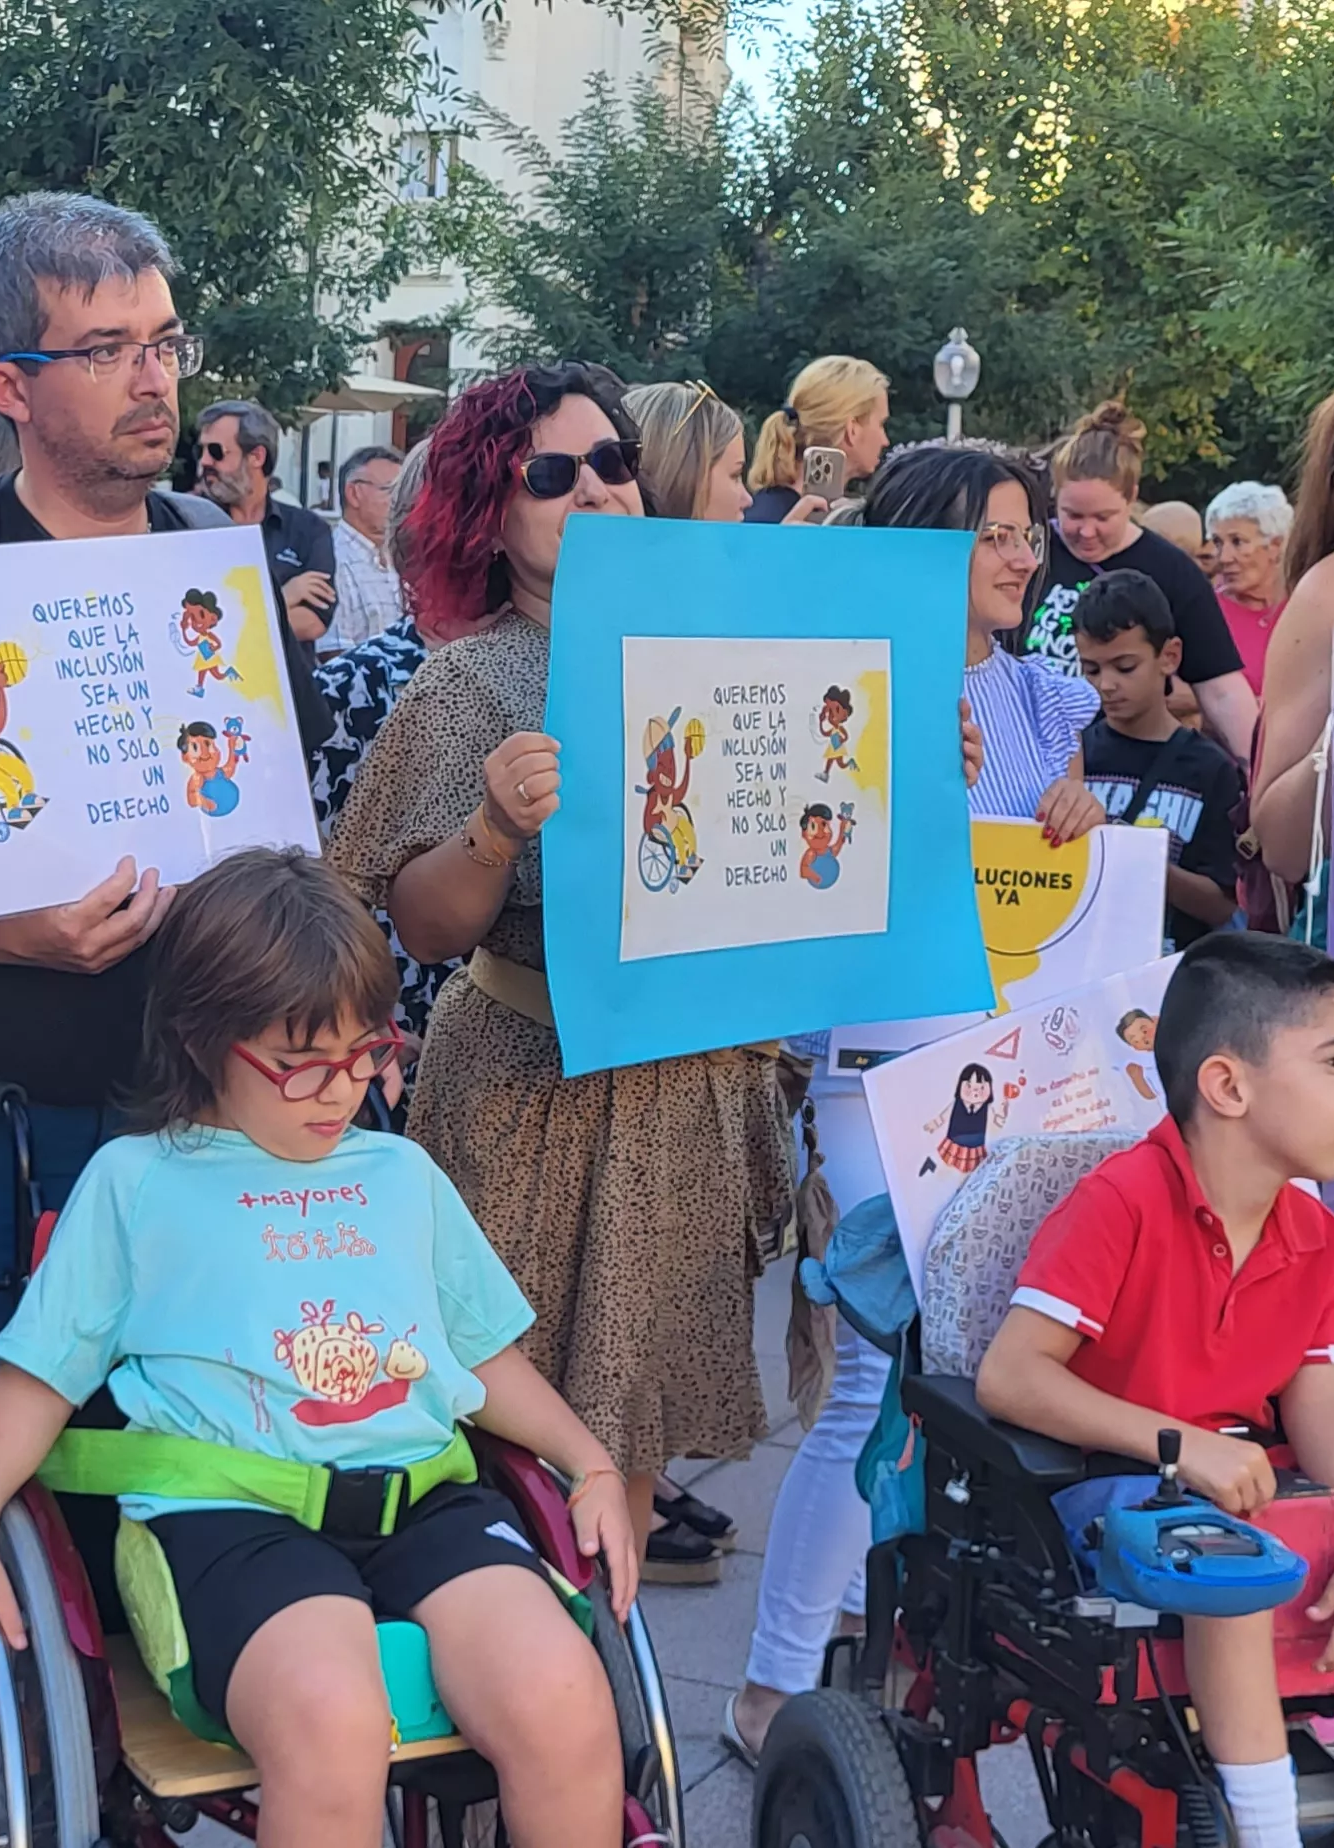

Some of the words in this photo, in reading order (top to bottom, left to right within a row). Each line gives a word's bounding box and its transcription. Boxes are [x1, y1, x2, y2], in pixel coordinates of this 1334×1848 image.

[32, 592, 134, 624] QUEREMOS
[68, 625, 106, 650] QUE
[114, 622, 140, 646] LA
[55, 644, 145, 680] INCLUSIÓN
[80, 683, 119, 707] SEA
[127, 680, 150, 701] UN
[713, 684, 786, 706] QUEREMOS
[74, 711, 135, 736] HECHO
[141, 705, 153, 730] Y
[733, 711, 762, 731] QUE
[768, 710, 786, 731] LA
[86, 743, 110, 765] NO
[117, 737, 160, 762] SOLO
[722, 729, 786, 756] INCLUSIÓN
[143, 764, 165, 787] UN
[735, 762, 763, 783] SEA
[770, 762, 786, 781] UN
[727, 788, 771, 808] HECHO
[779, 785, 787, 807] Y
[86, 794, 170, 825] DERECHO
[732, 815, 749, 834] NO
[756, 812, 787, 835] SOLO
[770, 839, 787, 857] UN
[725, 864, 787, 887] DERECHO
[974, 867, 1073, 890] LUCIONES
[994, 888, 1020, 906] YA
